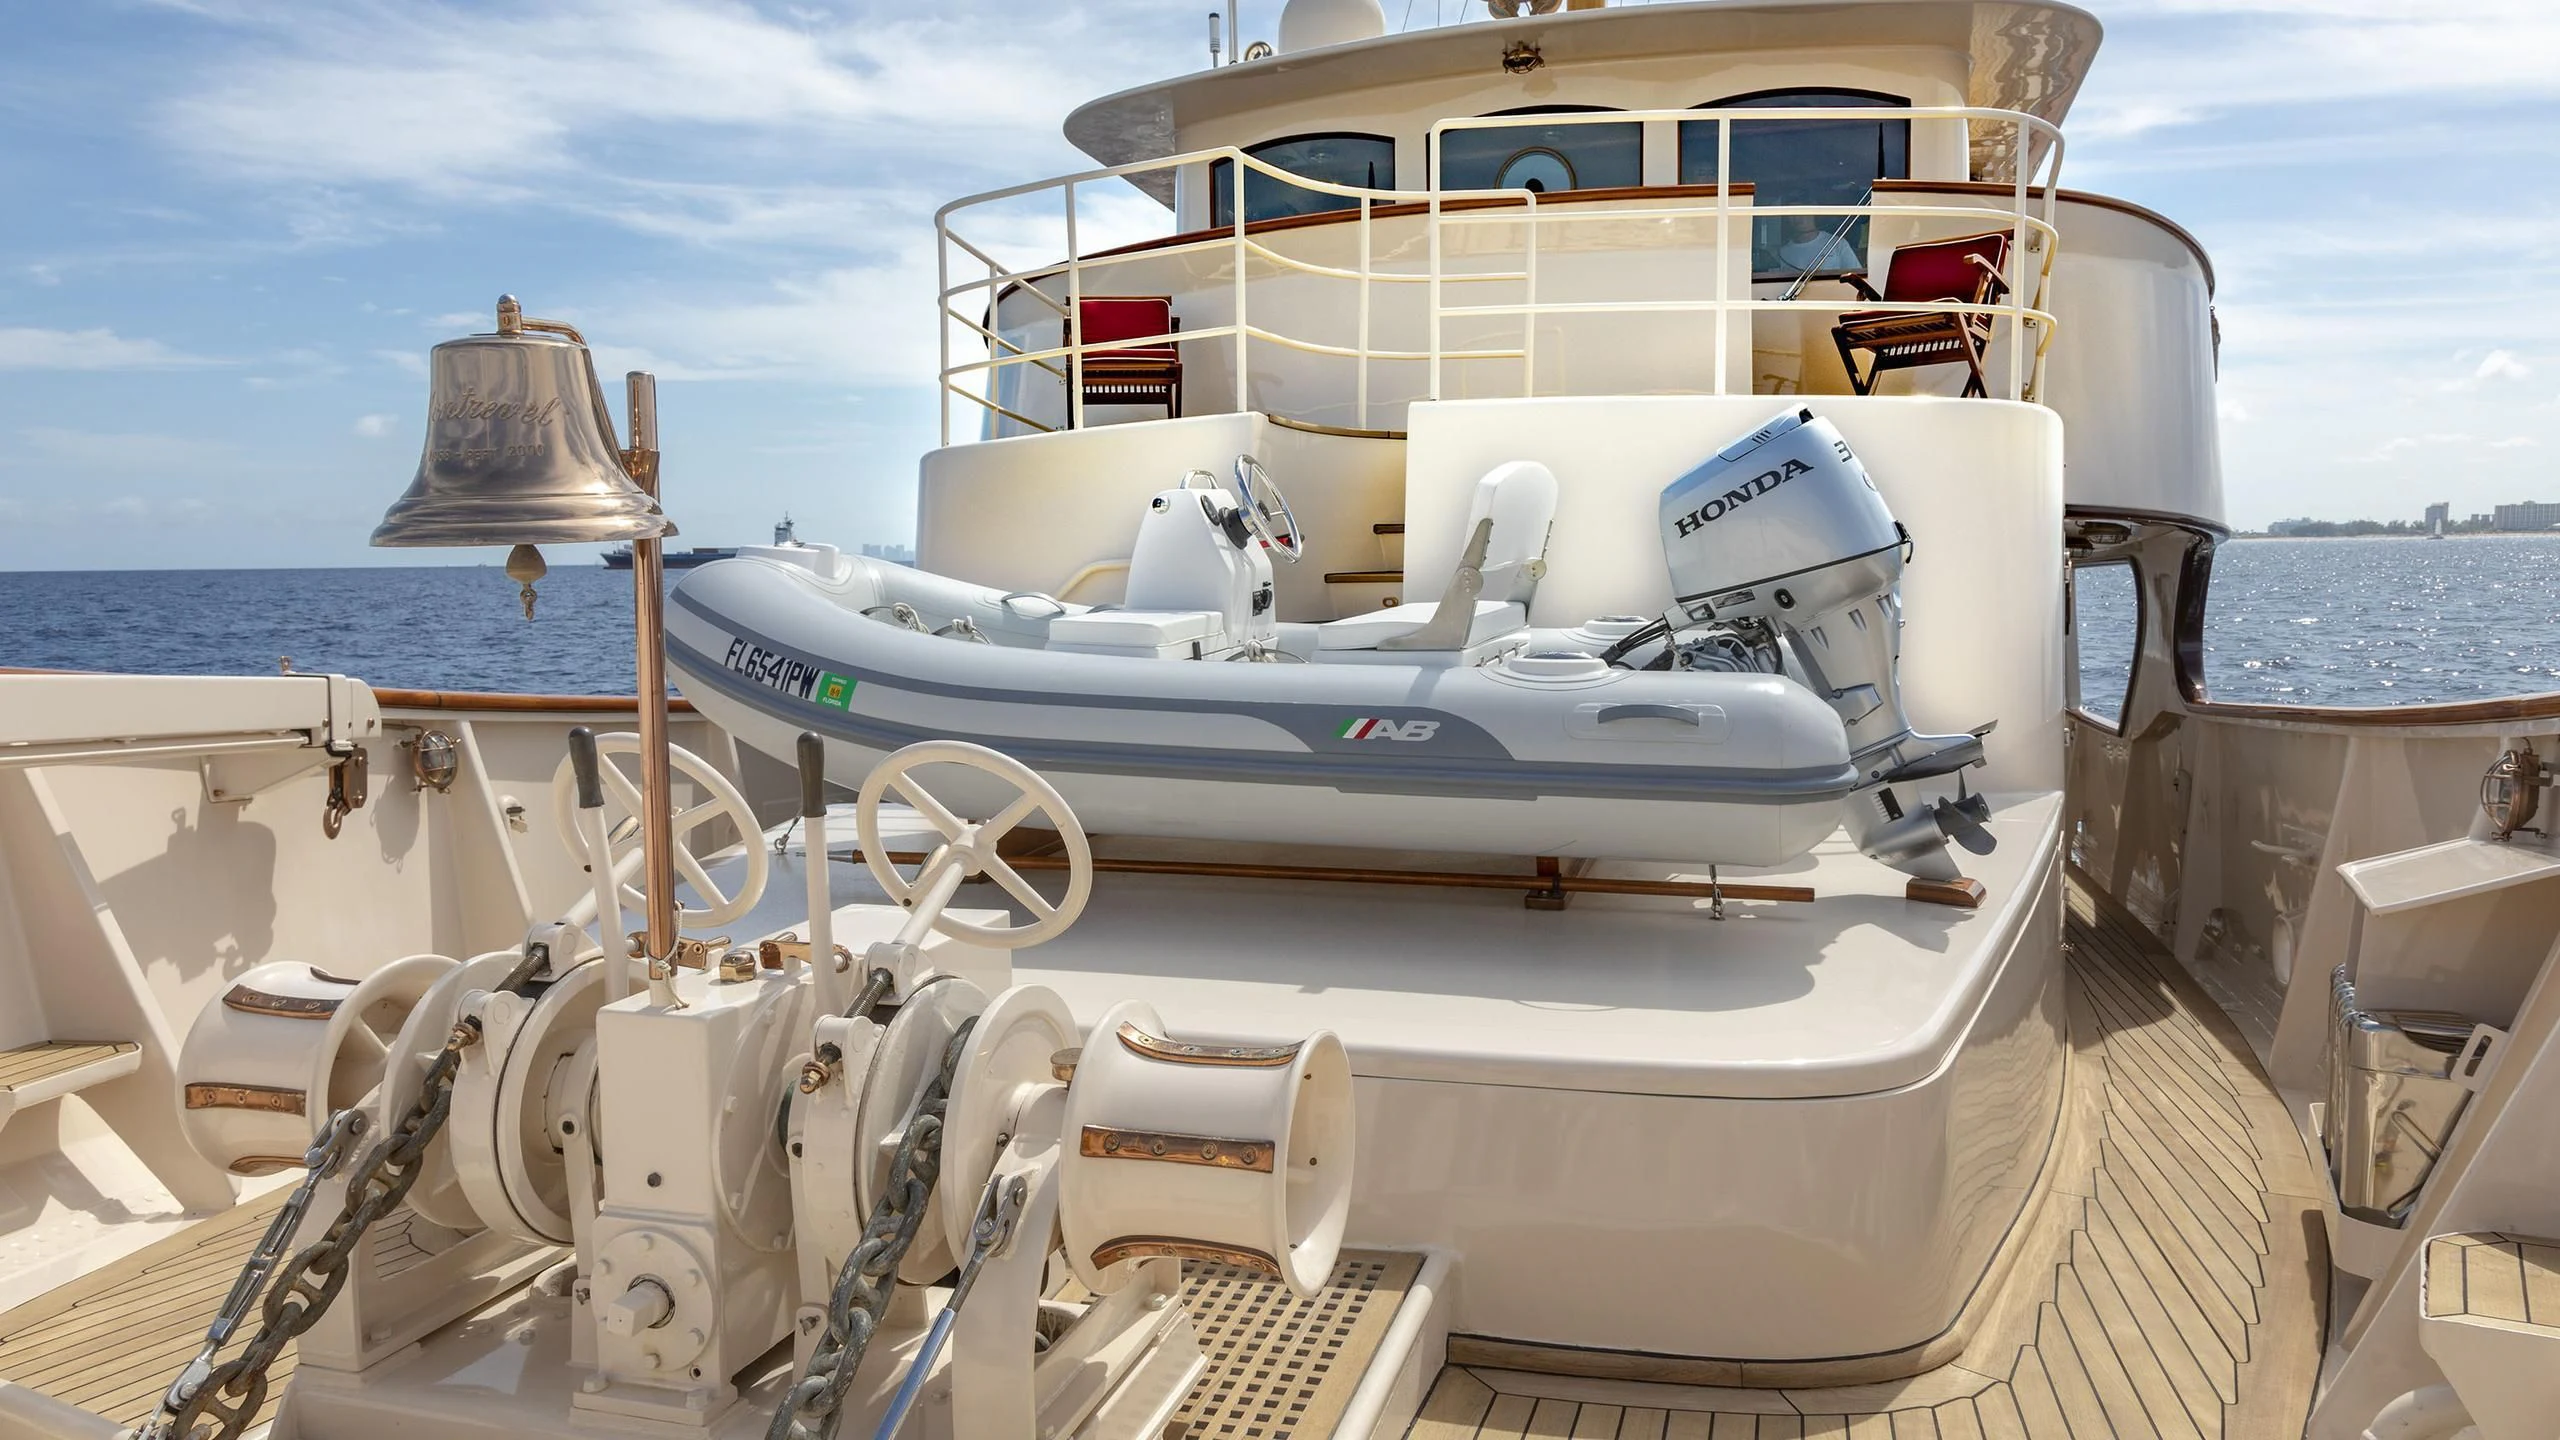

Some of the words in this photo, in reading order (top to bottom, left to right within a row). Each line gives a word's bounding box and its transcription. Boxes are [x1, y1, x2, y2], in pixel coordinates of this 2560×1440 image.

[1674, 458, 1814, 539] HONDA
[724, 637, 821, 700] FL6541PW
[1363, 718, 1441, 742] AB
